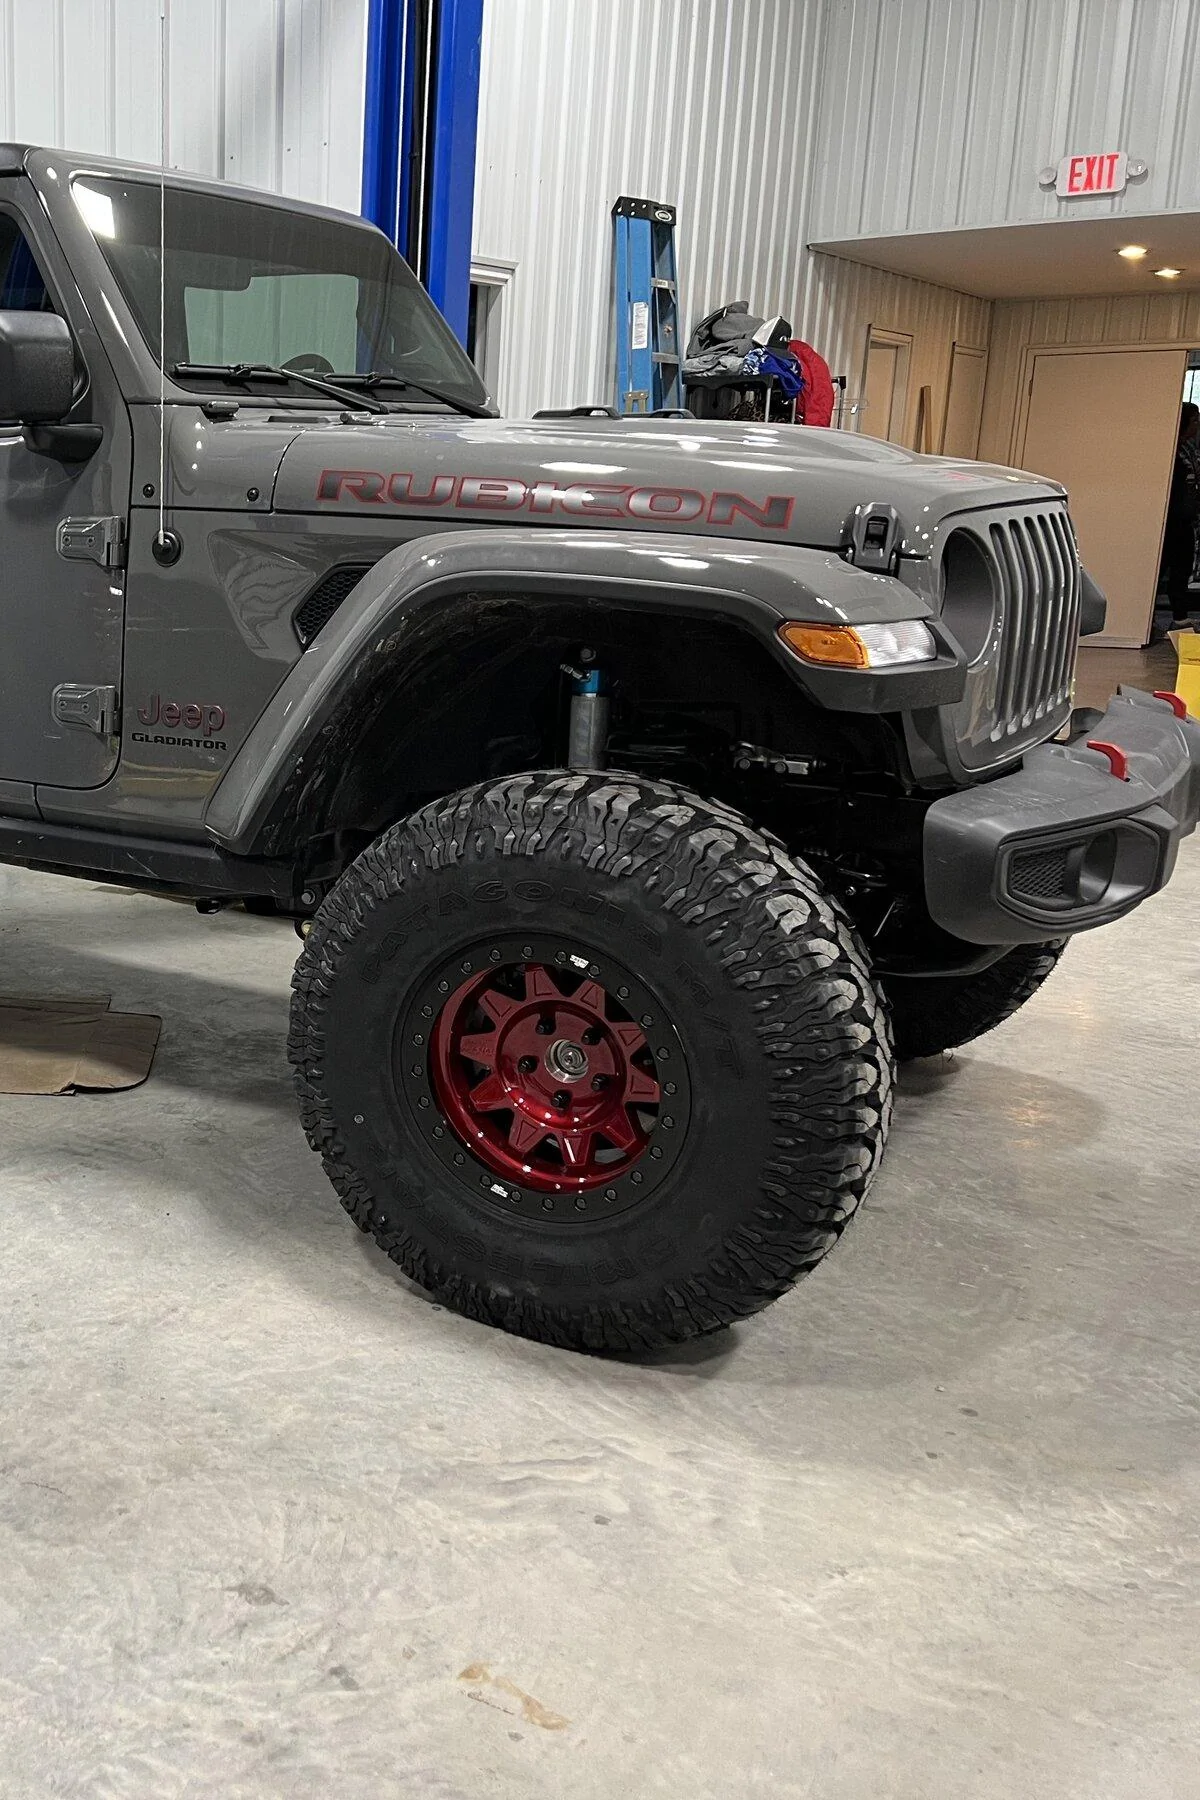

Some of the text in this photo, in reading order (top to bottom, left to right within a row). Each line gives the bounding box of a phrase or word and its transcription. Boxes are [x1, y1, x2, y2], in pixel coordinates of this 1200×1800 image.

[1068, 154, 1119, 192] EXIT
[316, 469, 795, 529] RUBICON
[137, 693, 225, 737] Jeep
[131, 733, 227, 751] GLADIATOR
